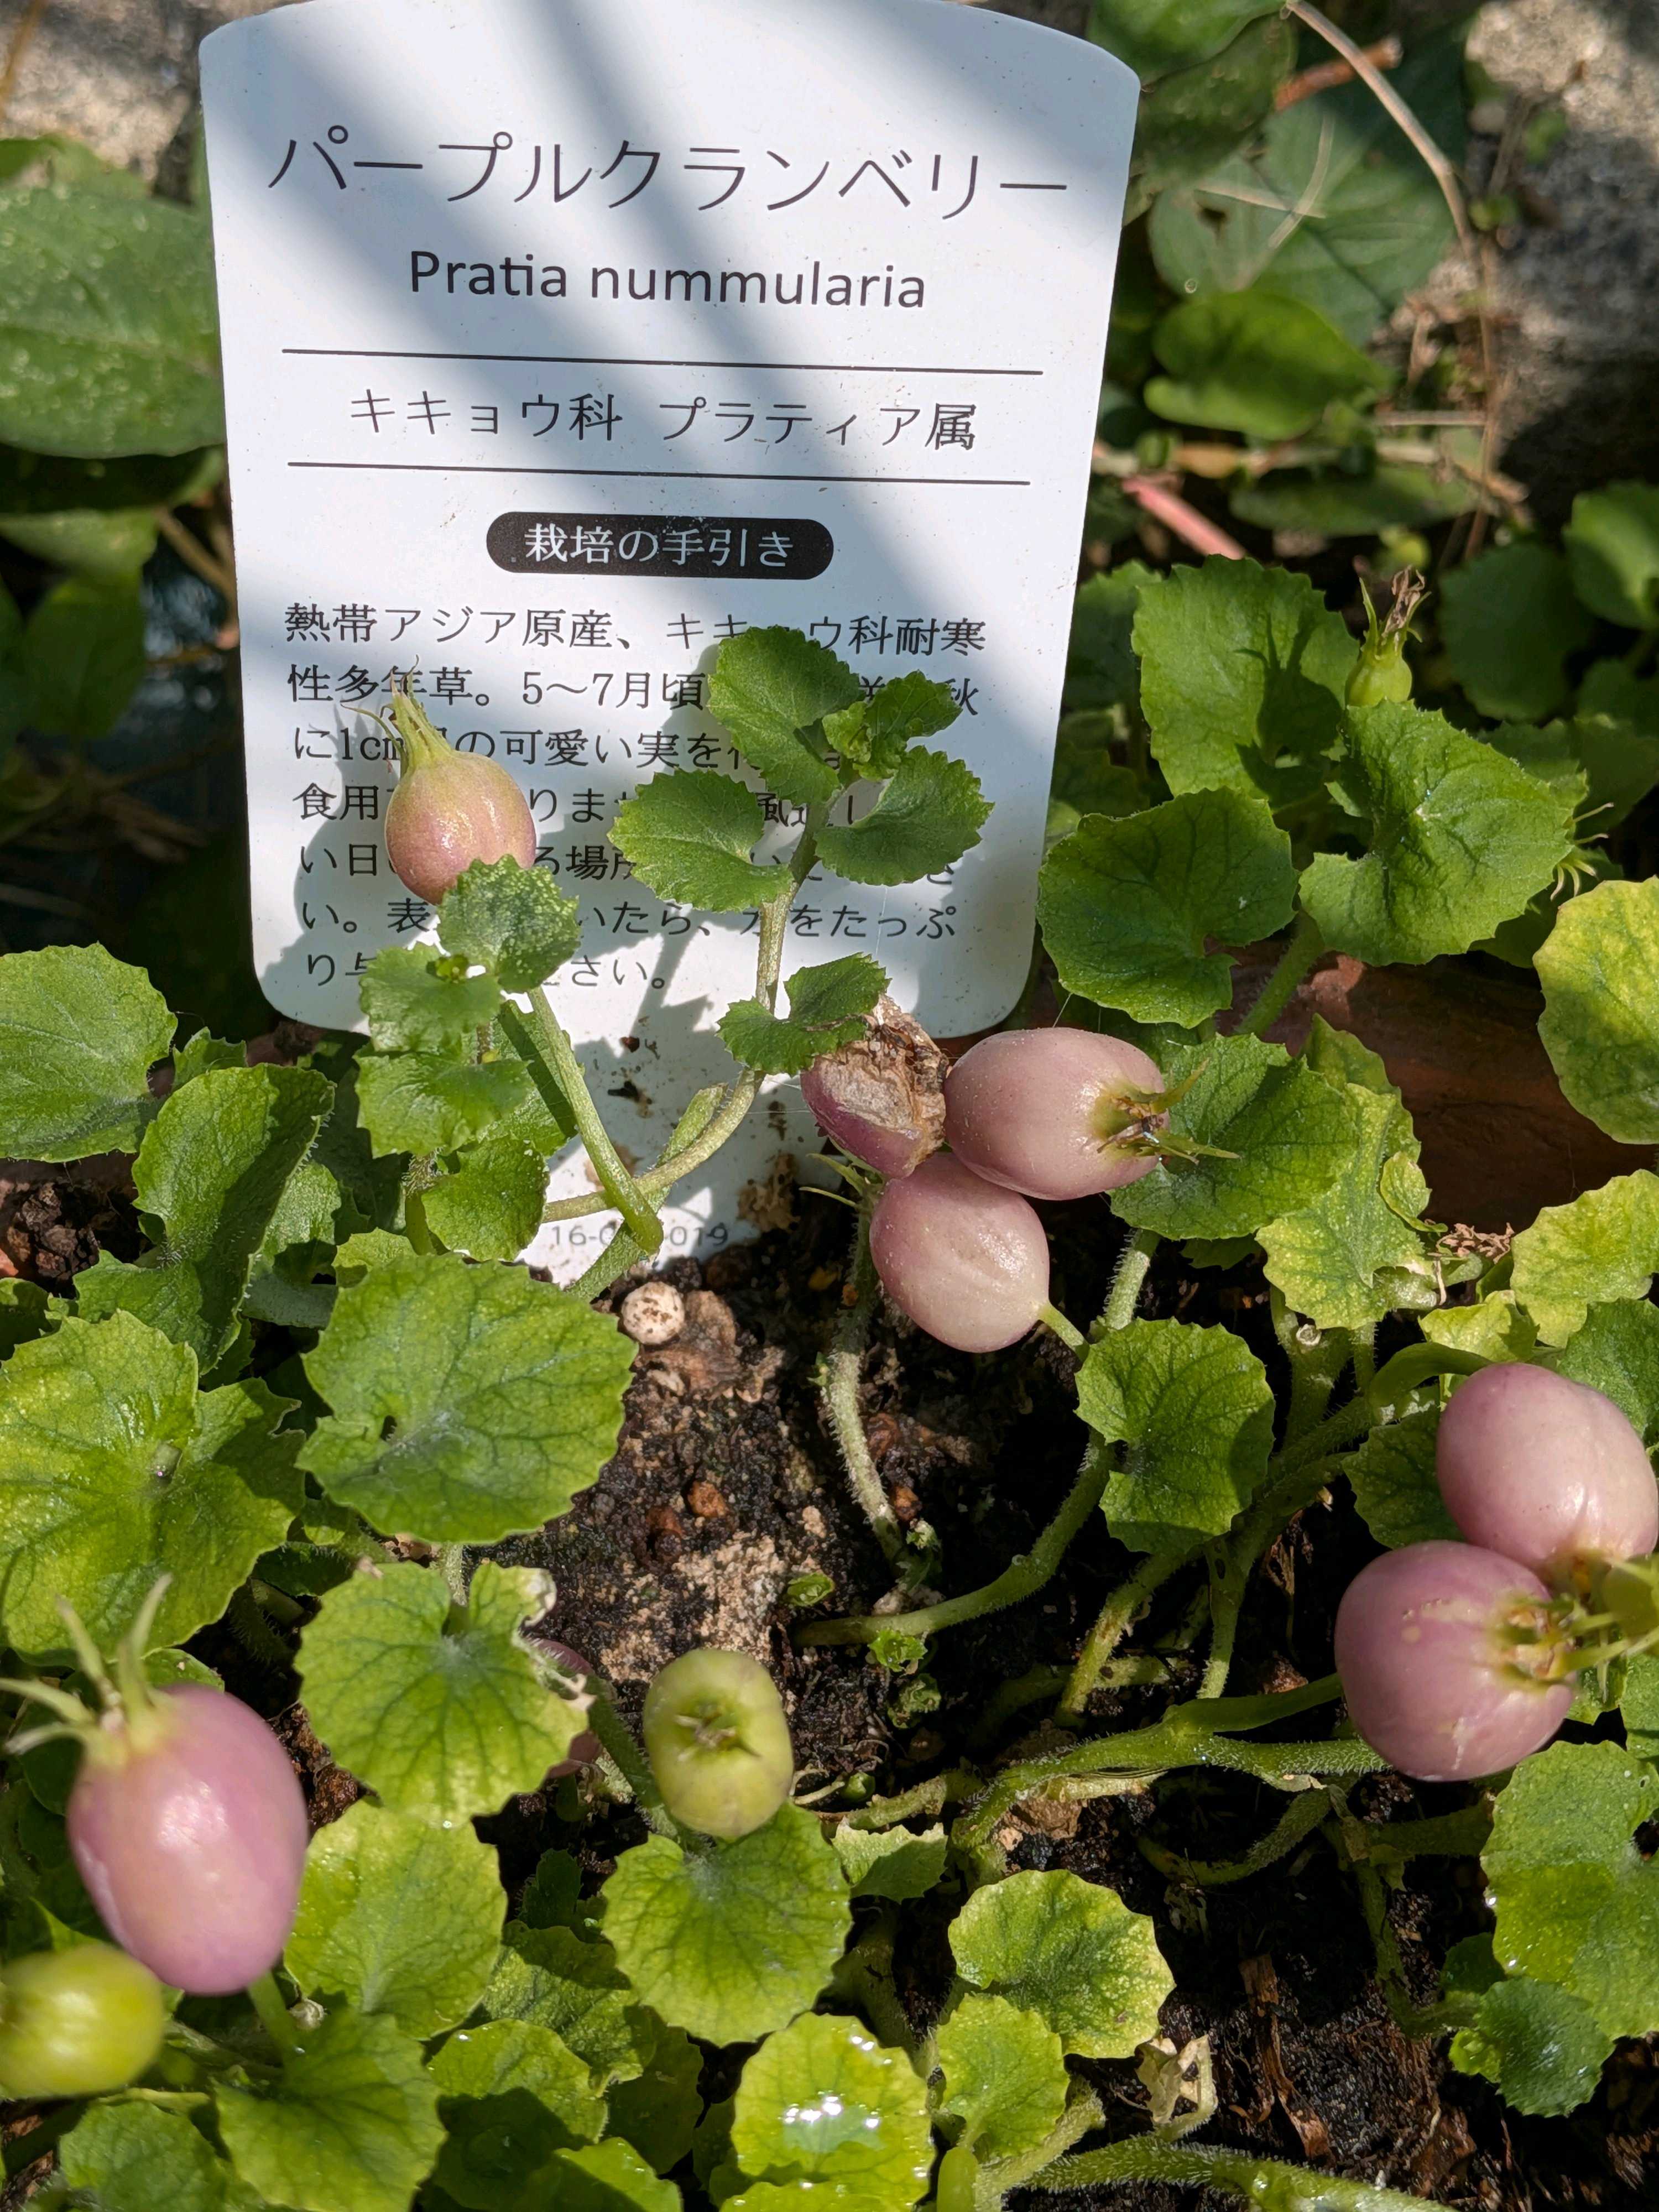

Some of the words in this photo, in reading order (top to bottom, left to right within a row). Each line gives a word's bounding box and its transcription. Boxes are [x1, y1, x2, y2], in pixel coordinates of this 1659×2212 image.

[268, 124, 1067, 220] パープルクランベリー
[411, 250, 566, 299] Pratia
[592, 260, 925, 309] nummularia
[351, 389, 623, 442] キキョウ科
[659, 390, 977, 453] プラティア属
[524, 523, 794, 567] 栽培の手引き
[284, 602, 987, 656] 熱帯アジア原産、キキウ科耐寒
